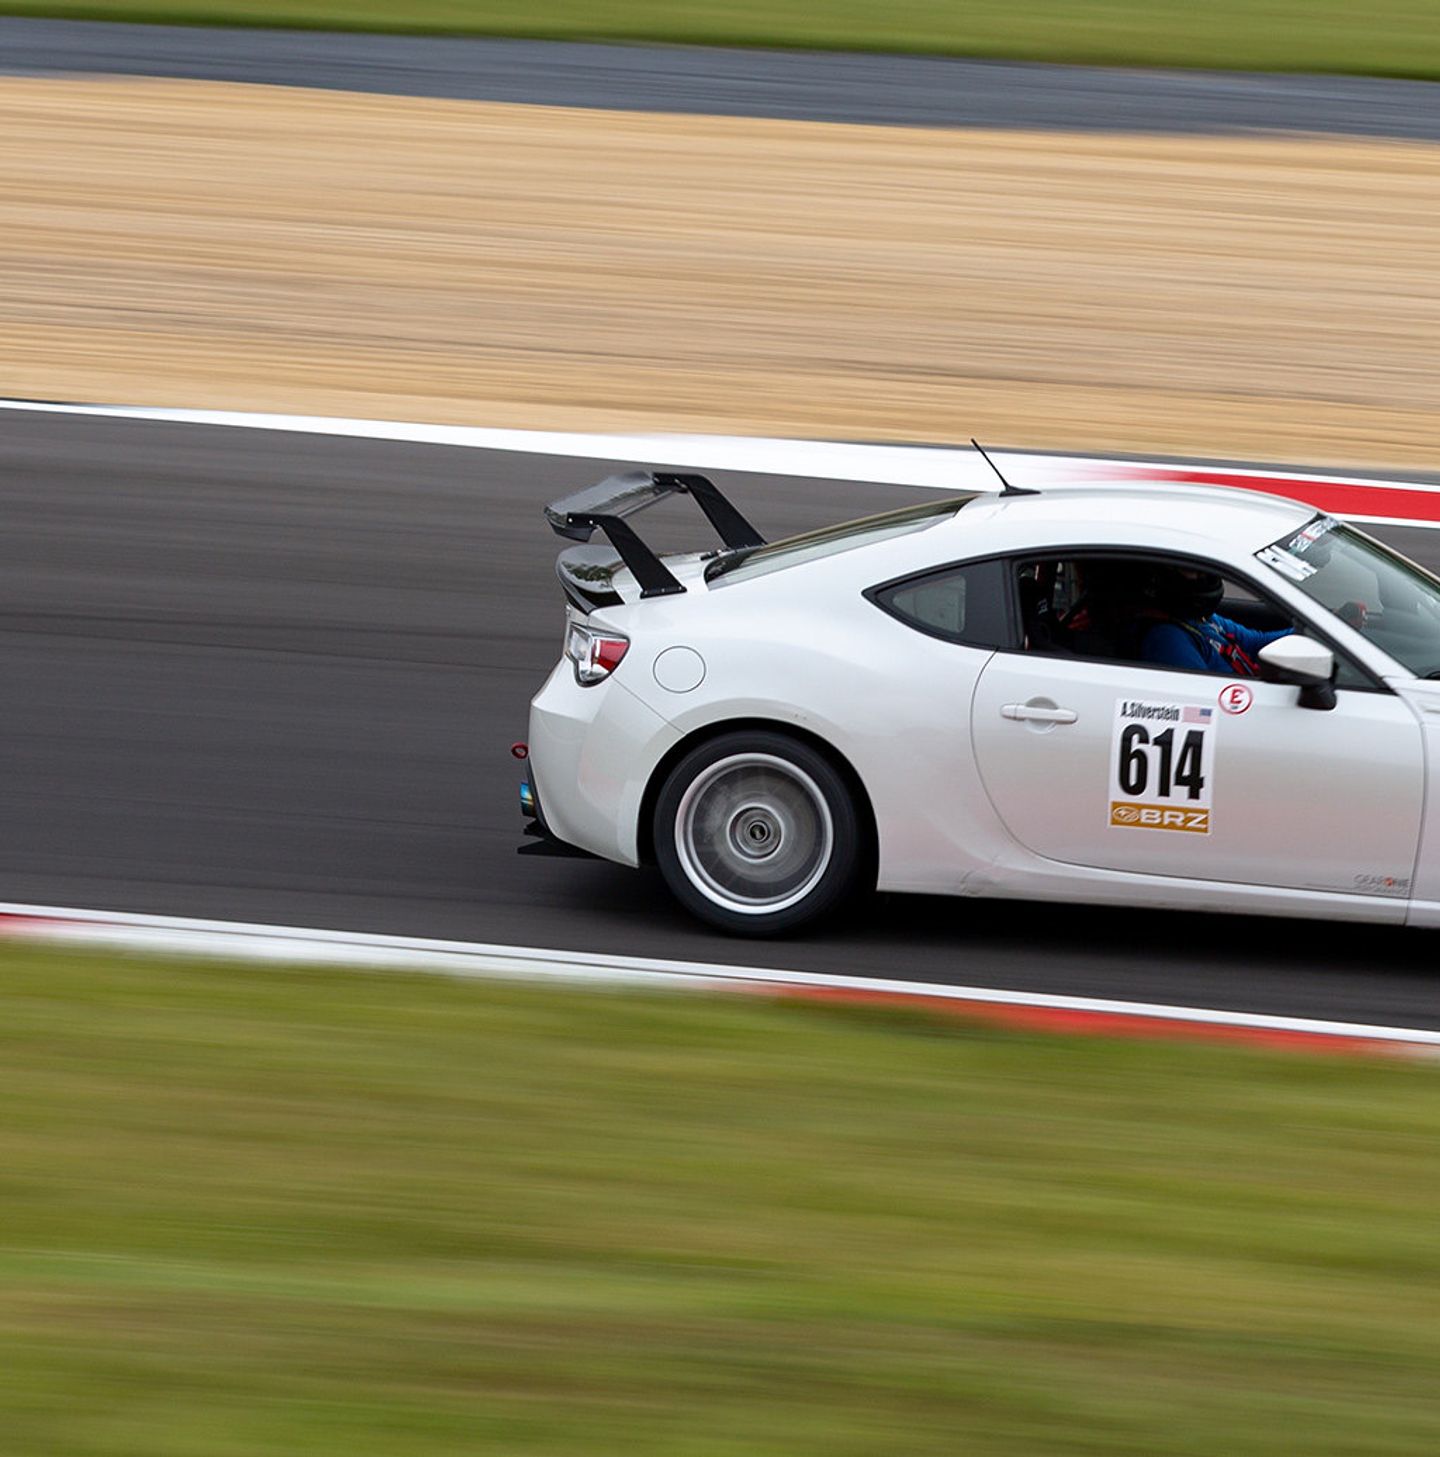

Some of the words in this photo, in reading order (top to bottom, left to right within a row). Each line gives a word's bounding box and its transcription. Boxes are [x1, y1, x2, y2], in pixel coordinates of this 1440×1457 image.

[1230, 688, 1245, 704] E
[1118, 723, 1206, 800] 614
[1139, 808, 1208, 829] BRZ
